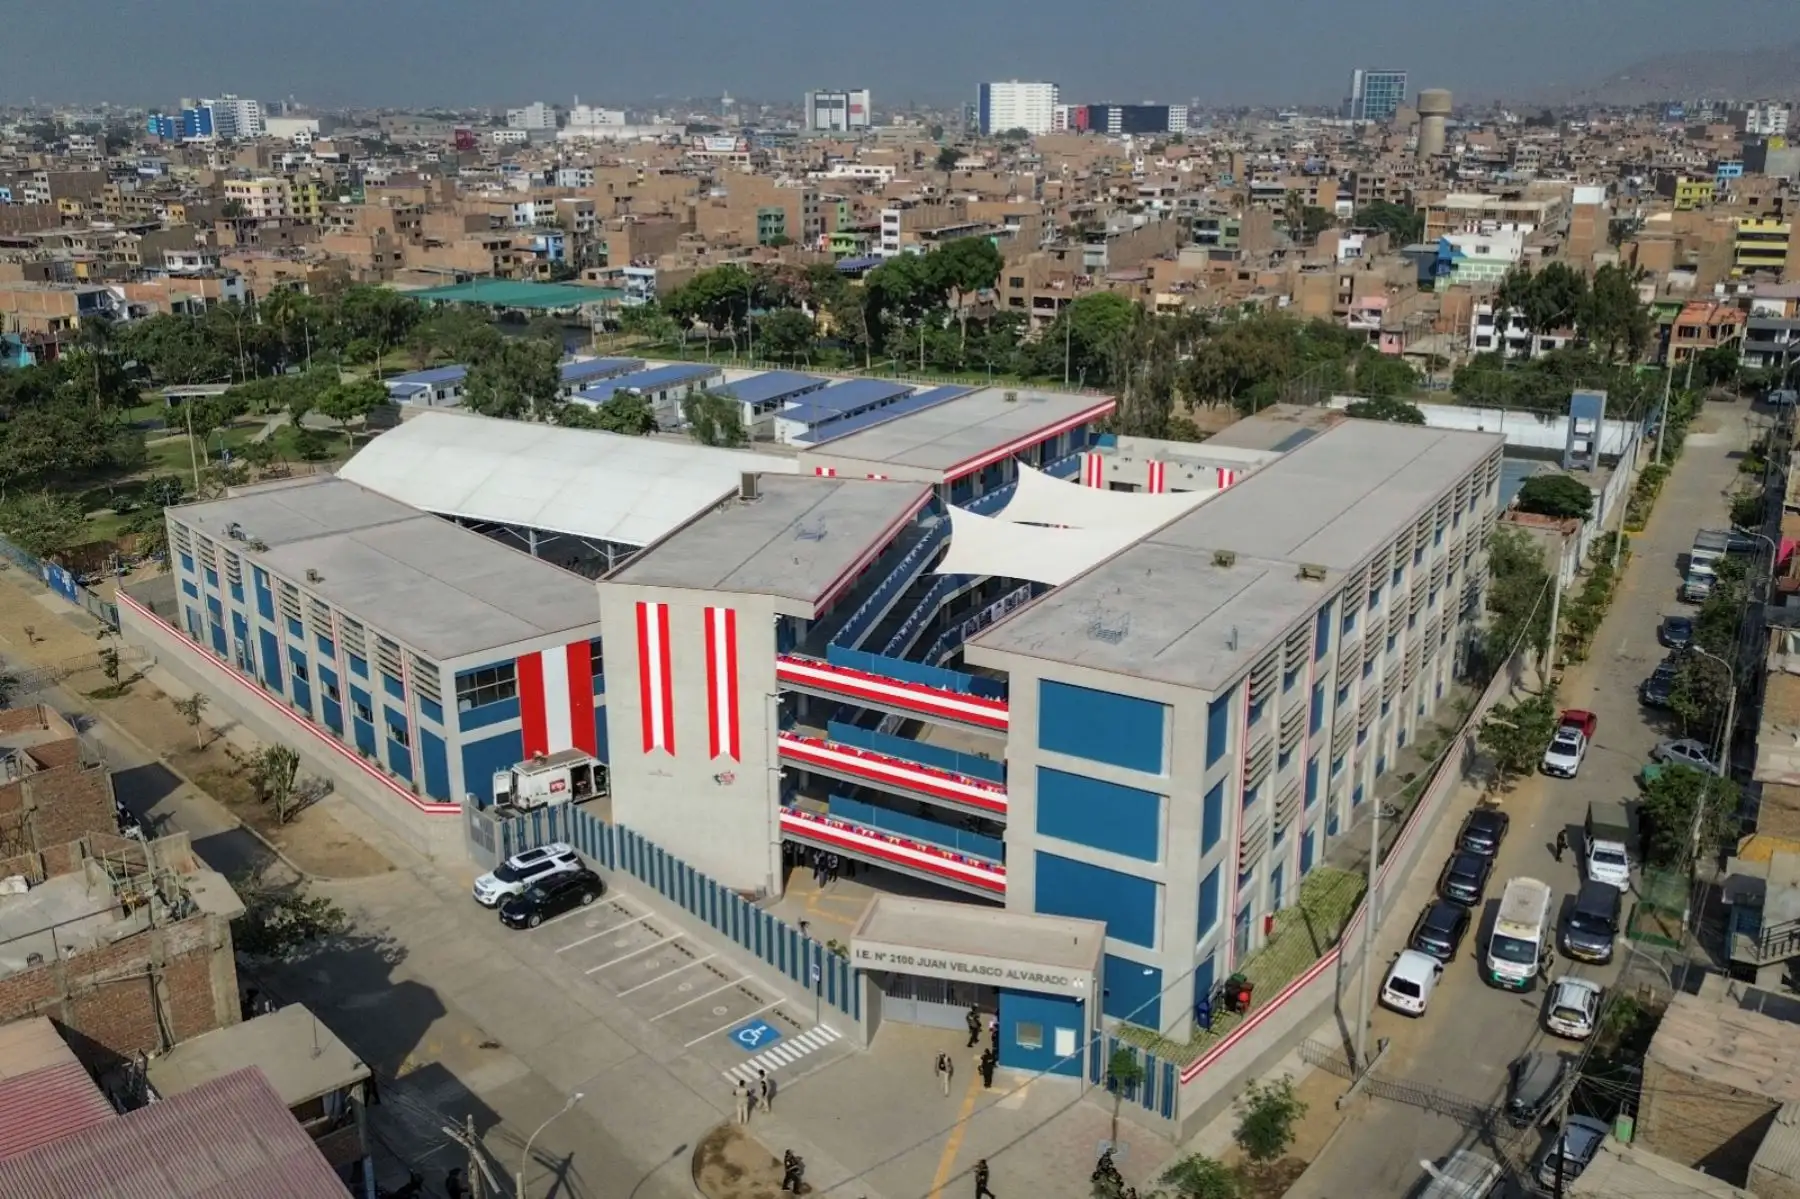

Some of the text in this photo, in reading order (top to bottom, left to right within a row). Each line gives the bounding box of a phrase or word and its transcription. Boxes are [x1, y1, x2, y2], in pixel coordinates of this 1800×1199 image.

[917, 958, 946, 969] JUAN
[950, 961, 1003, 977] VELASCO
[1006, 969, 1068, 986] ALVARADO
